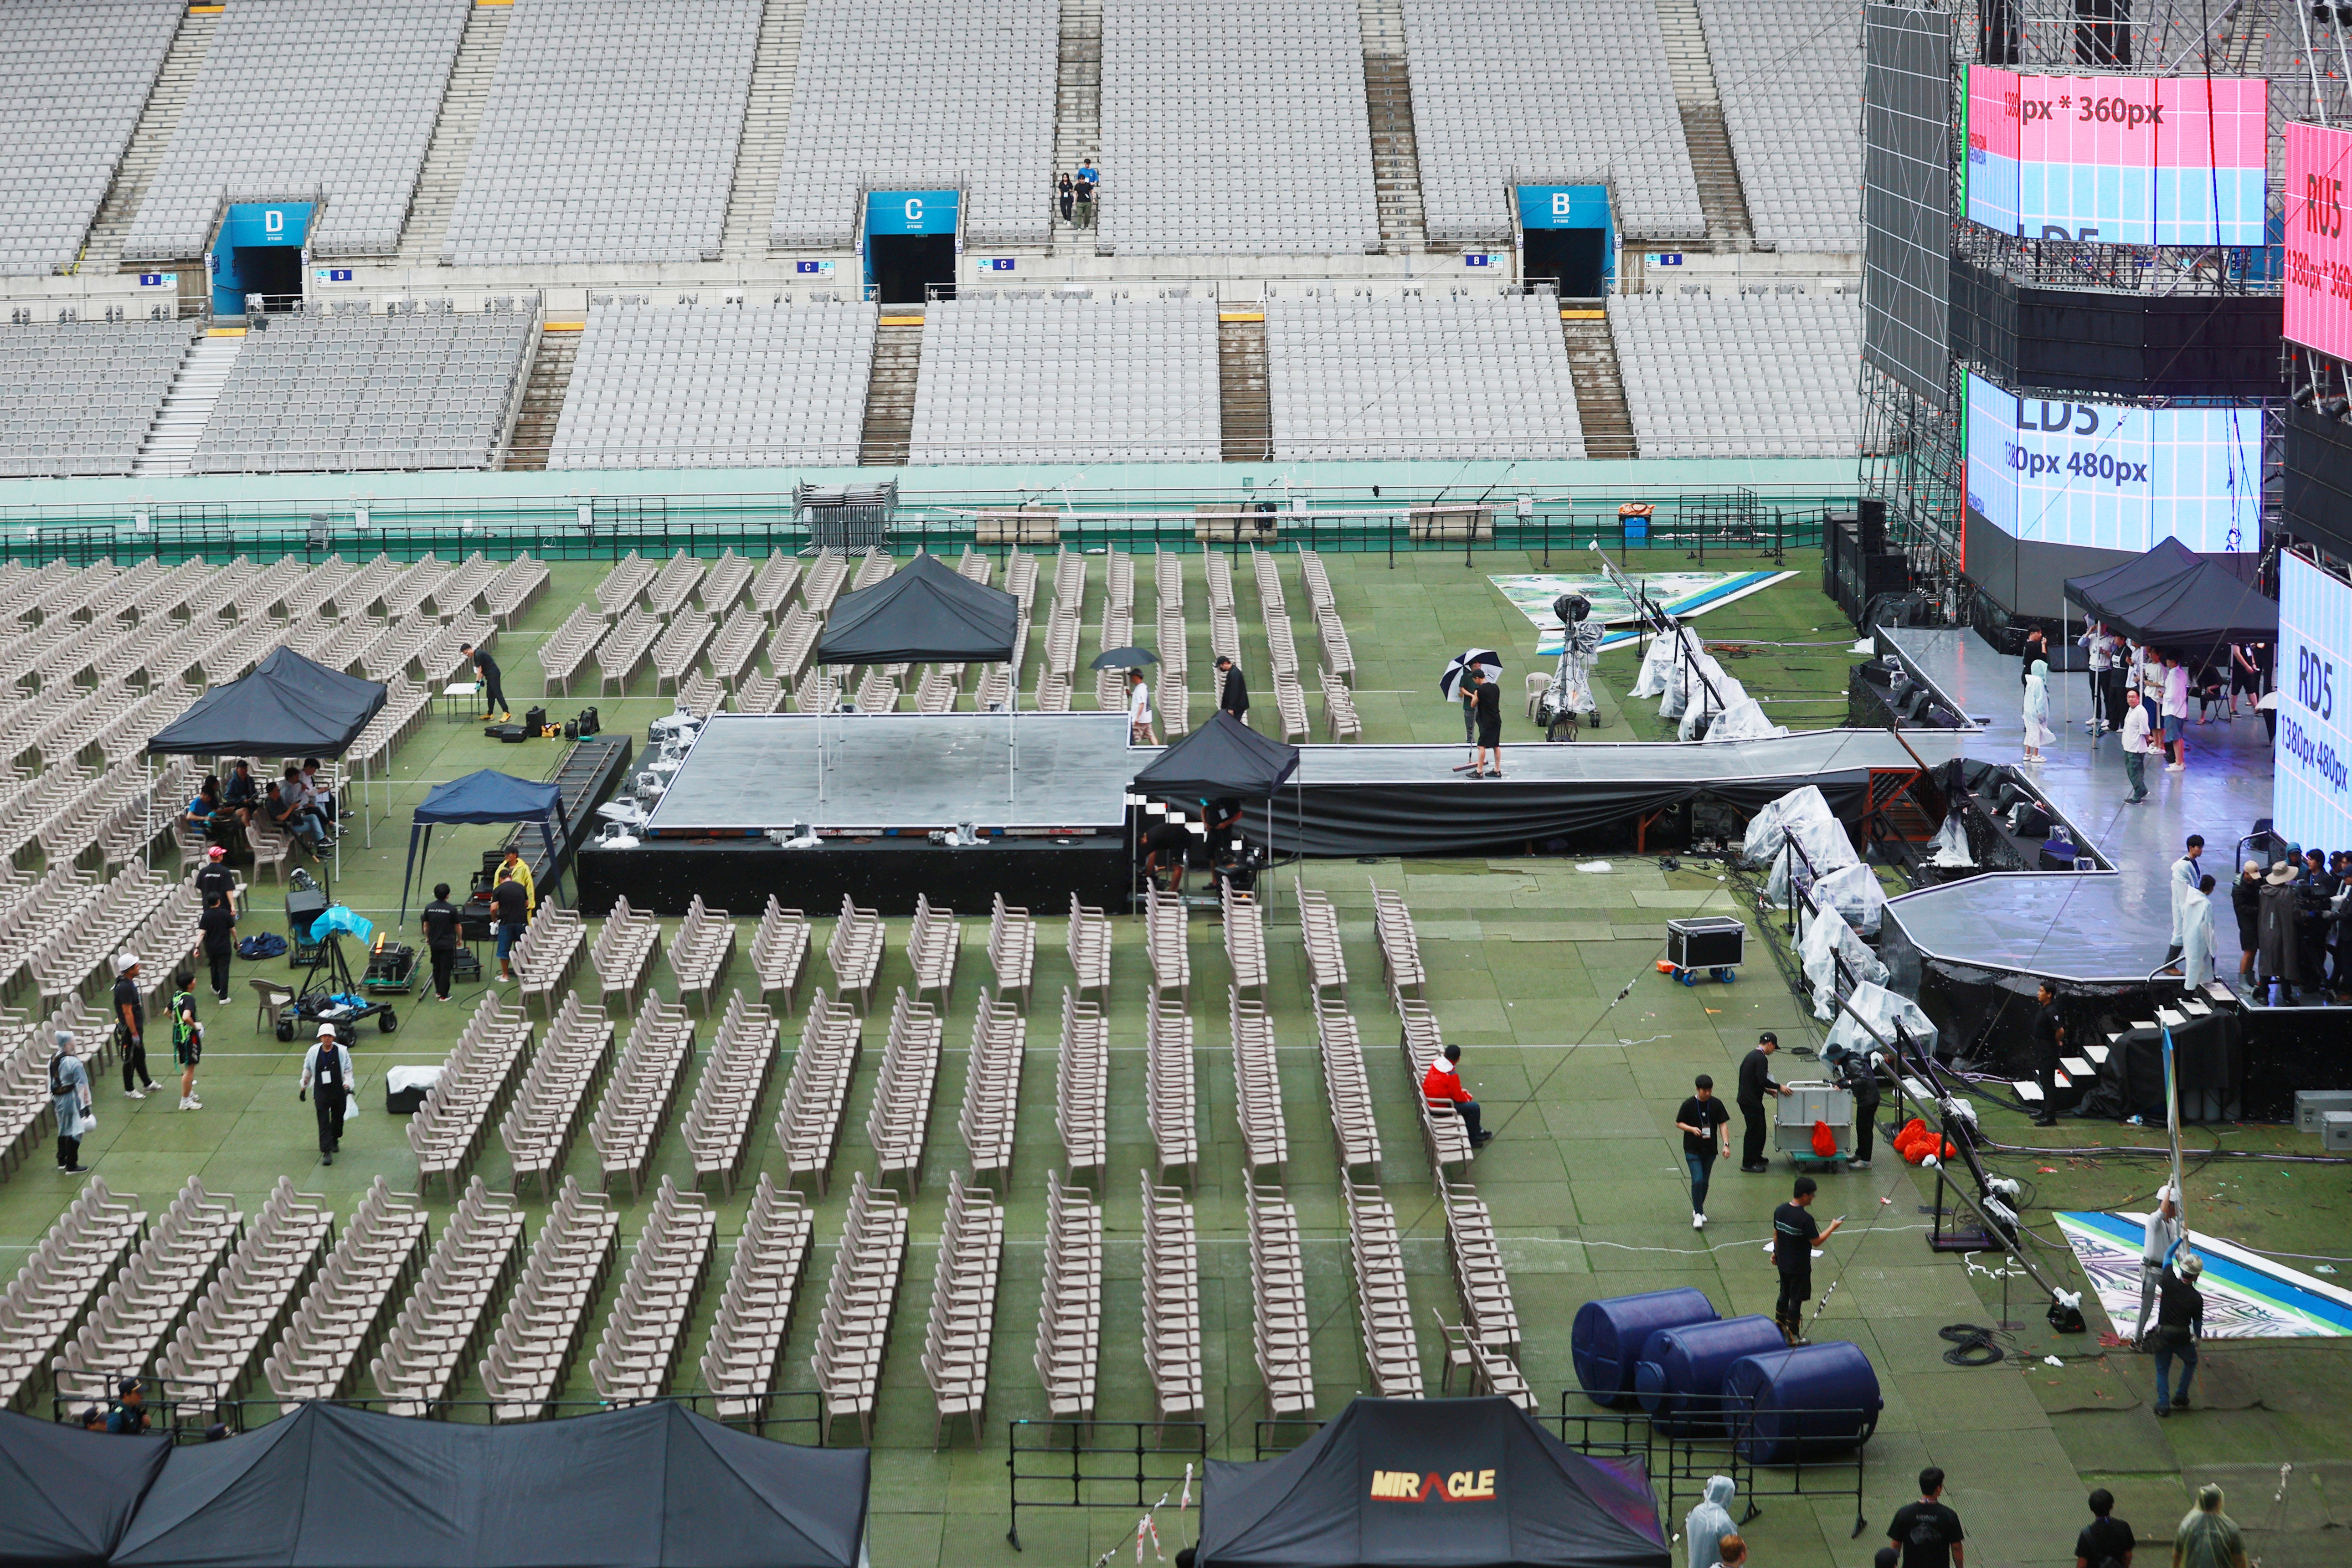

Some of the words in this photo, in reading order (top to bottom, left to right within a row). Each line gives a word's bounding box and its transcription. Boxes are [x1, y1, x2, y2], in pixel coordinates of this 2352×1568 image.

[2079, 96, 2164, 130] 360px
[266, 211, 283, 232] D
[905, 199, 922, 220] C
[1553, 193, 1570, 214] B
[2307, 174, 2342, 238] RU5
[2286, 249, 2321, 297] 1380px
[2005, 440, 2060, 478] 1380px
[2067, 452, 2147, 486] 480px
[2299, 645, 2332, 720] RD5
[2282, 715, 2315, 769] 1380px
[2317, 740, 2347, 794] 480px
[1370, 1469, 1497, 1502] MIRACLE
